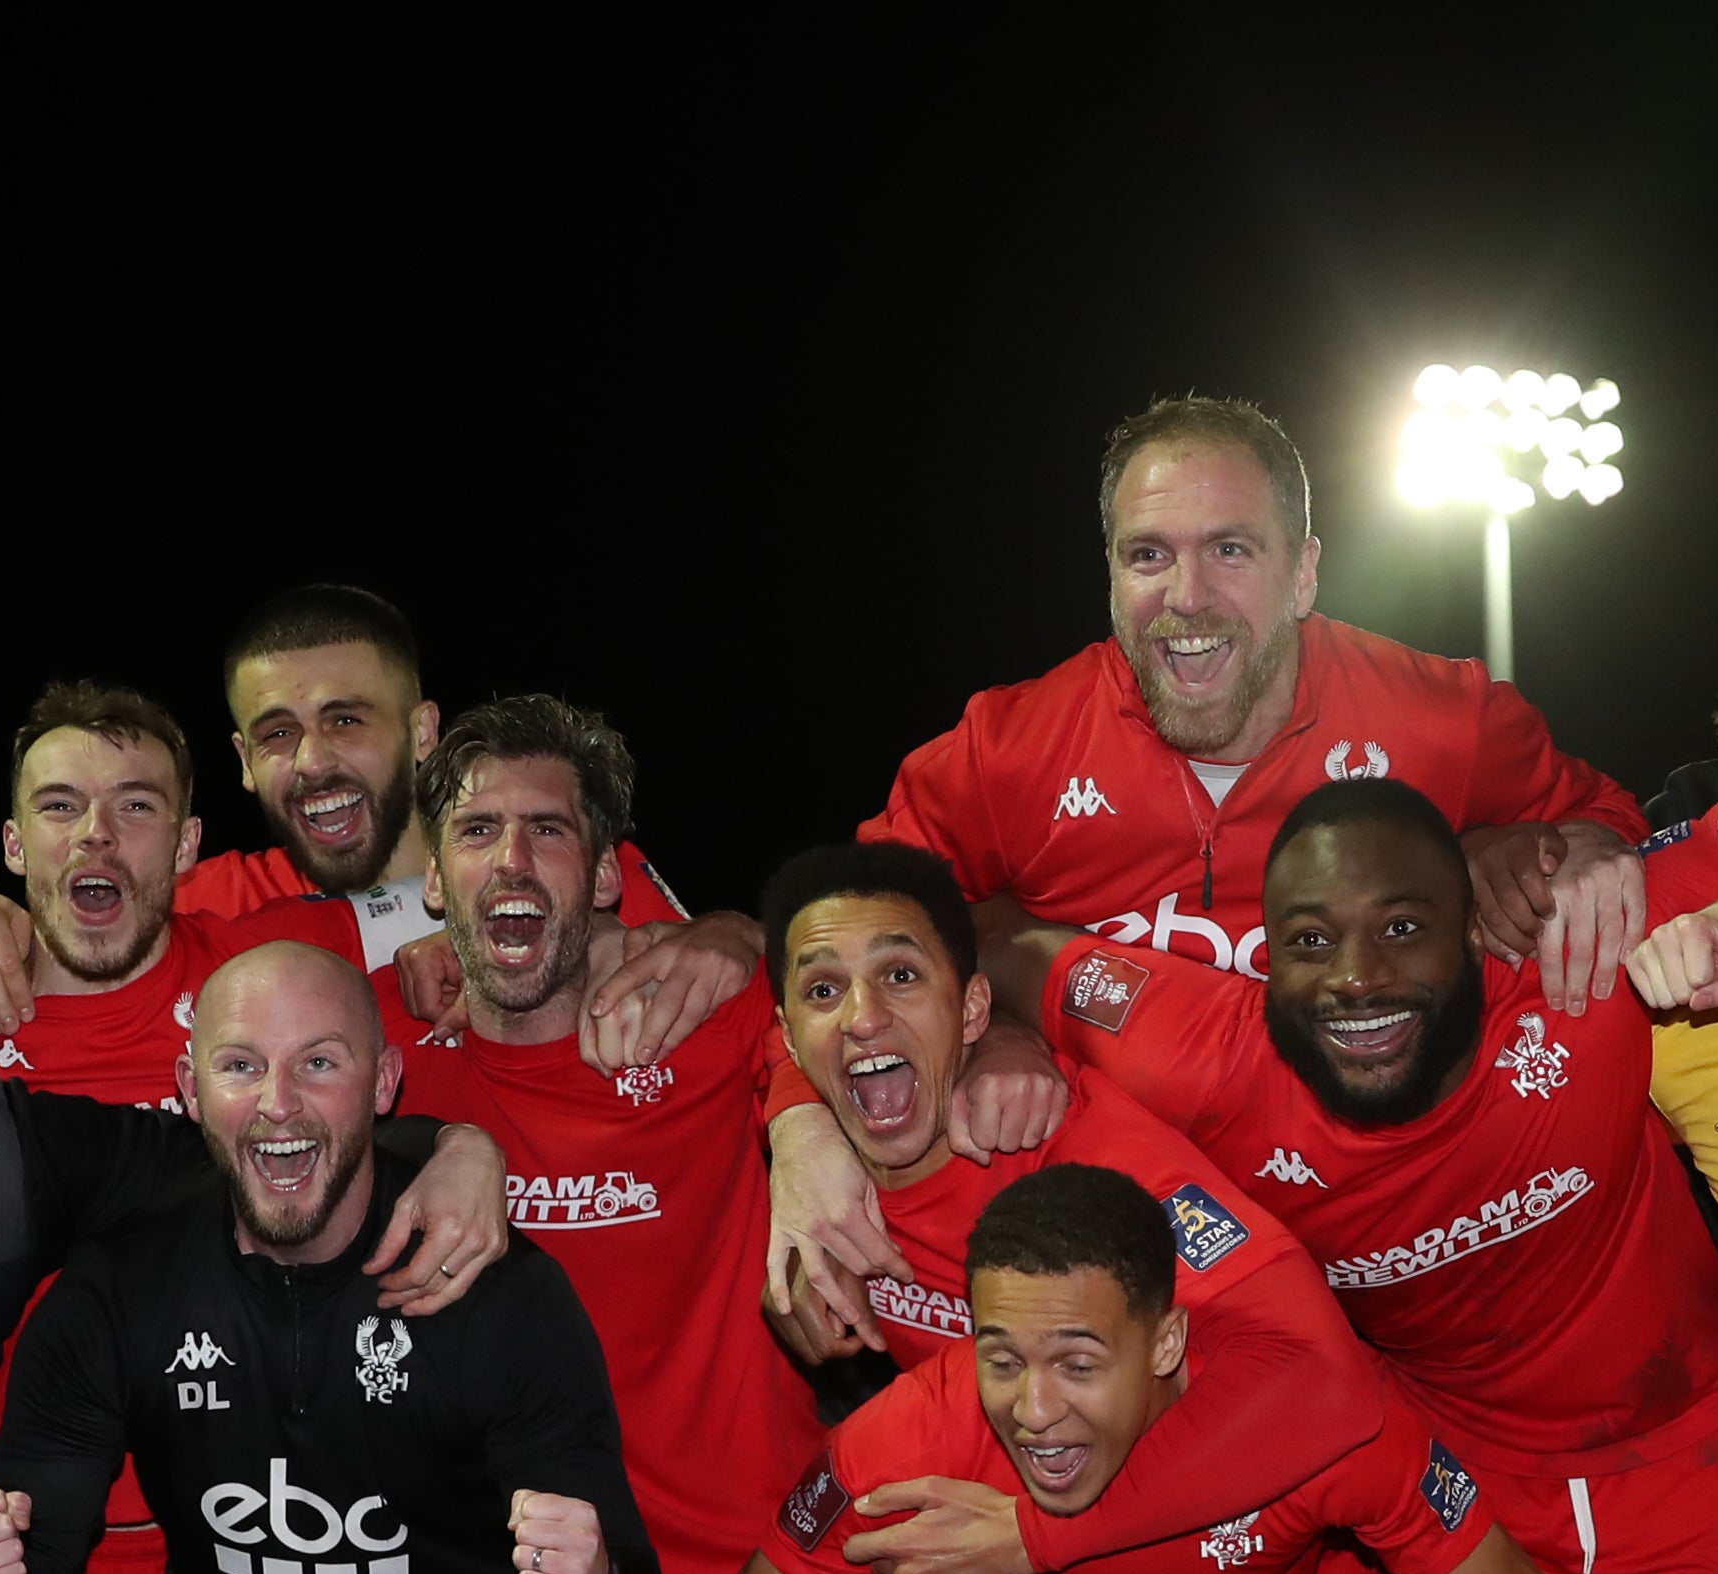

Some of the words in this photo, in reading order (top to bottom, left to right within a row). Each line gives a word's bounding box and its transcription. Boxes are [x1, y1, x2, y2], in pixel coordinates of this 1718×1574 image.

[1185, 1245, 1198, 1258] 5
[1196, 1220, 1236, 1249] STAR
[1327, 1209, 1520, 1286] HEWITT
[1381, 1189, 1520, 1266] ADAM
[177, 1380, 231, 1411] DL
[200, 1458, 409, 1554] ebc
[790, 1509, 814, 1533] CUP
